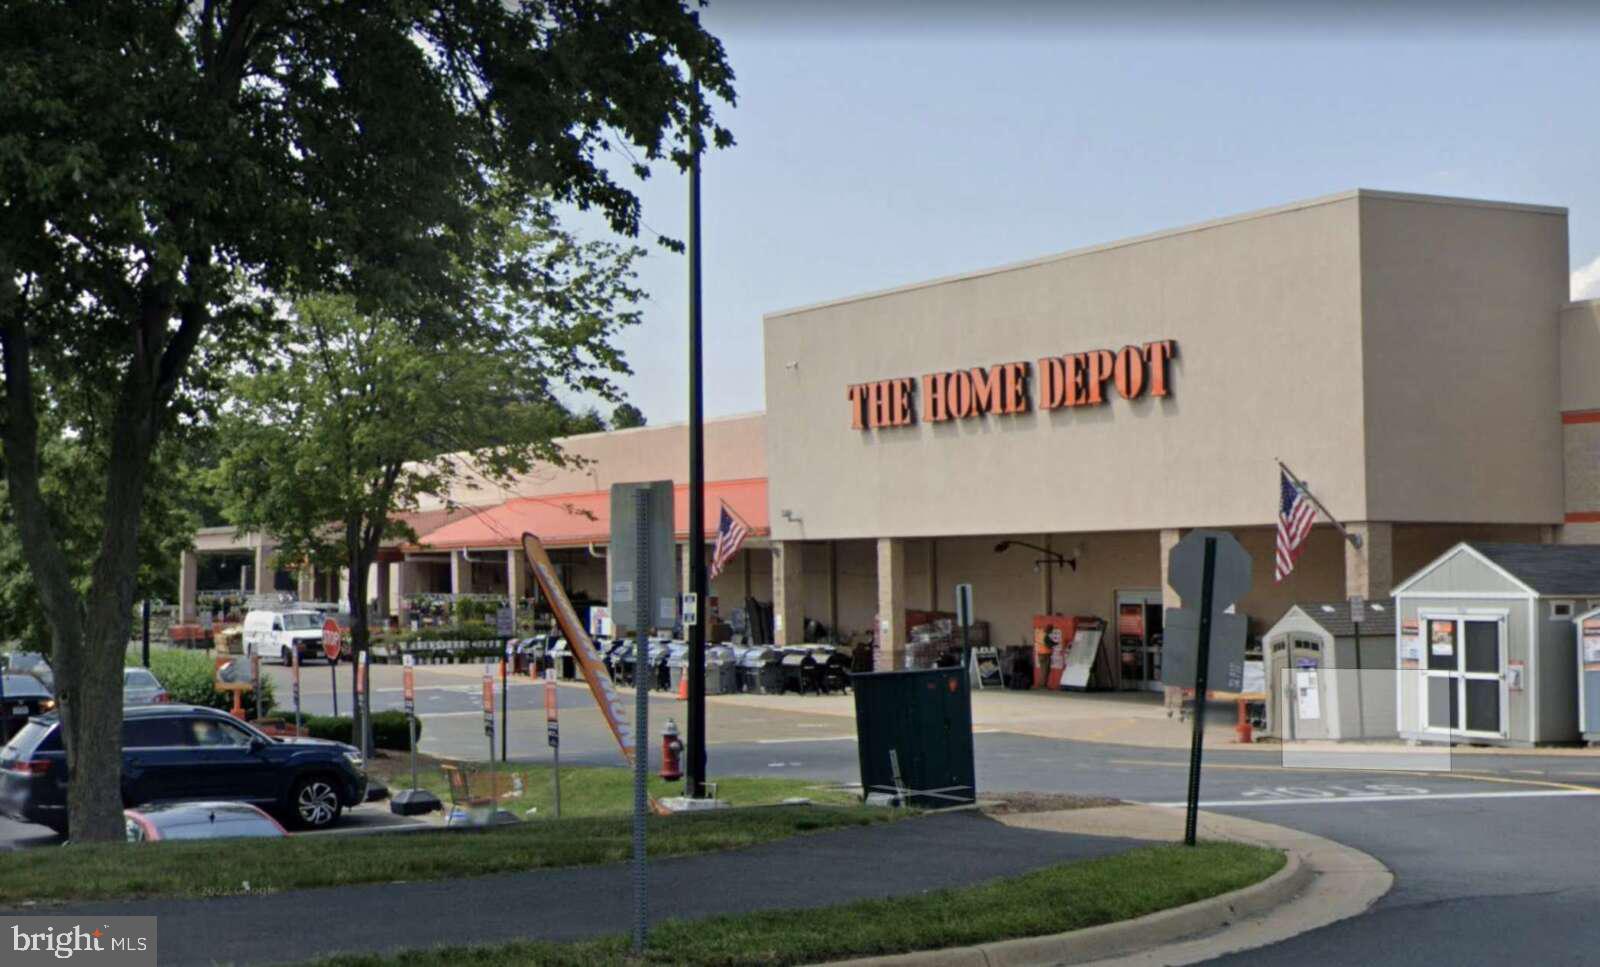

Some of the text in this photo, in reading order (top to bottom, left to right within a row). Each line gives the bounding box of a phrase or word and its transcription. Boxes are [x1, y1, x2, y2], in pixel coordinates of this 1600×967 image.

[848, 339, 1177, 430] THE HOME DEPOT
